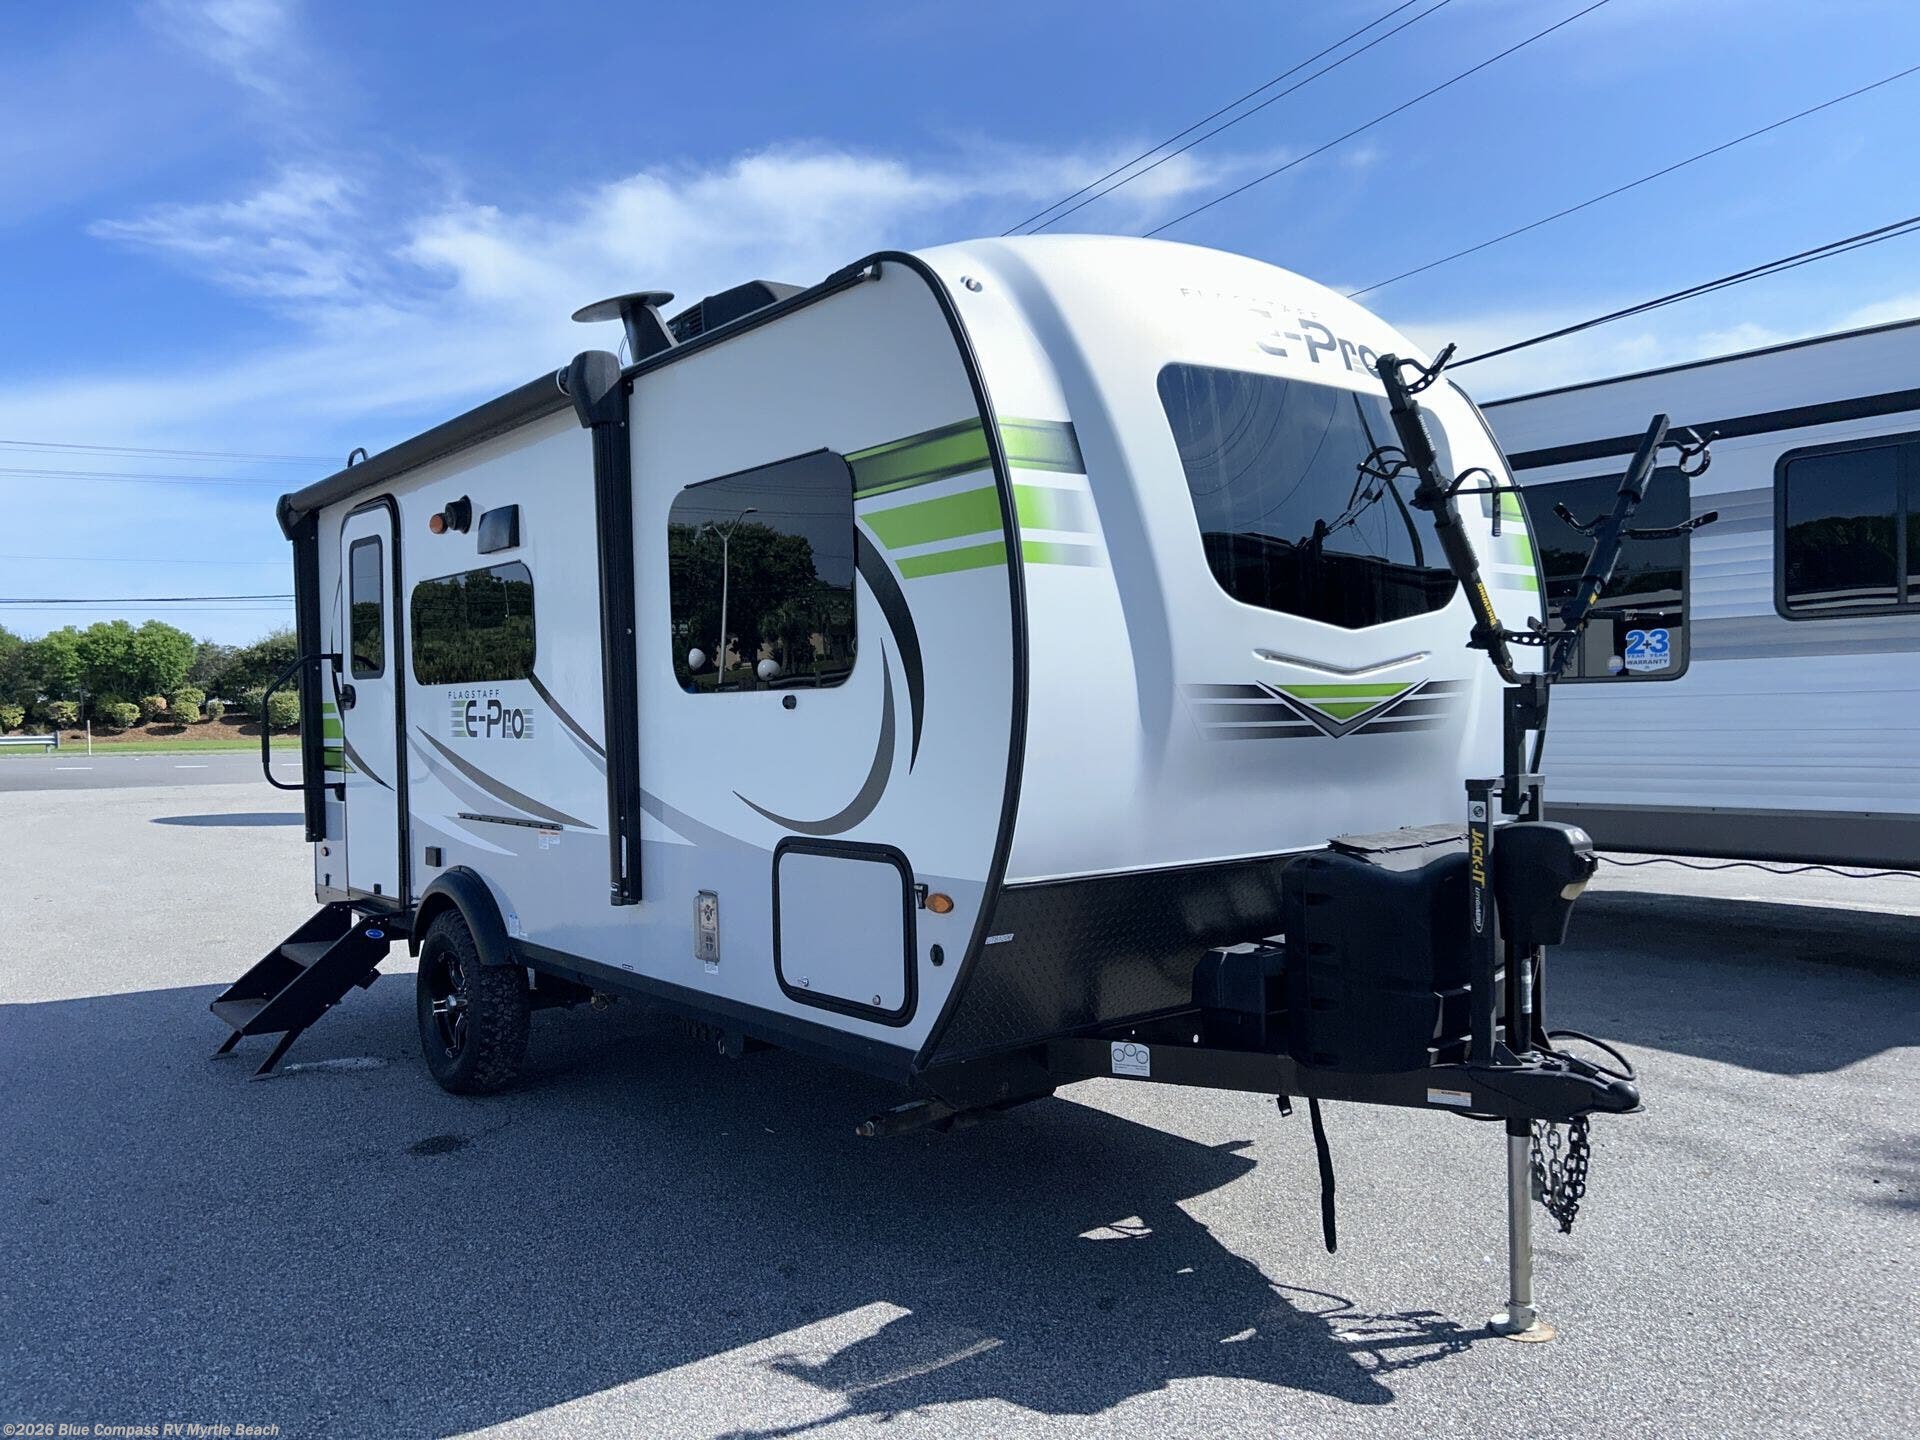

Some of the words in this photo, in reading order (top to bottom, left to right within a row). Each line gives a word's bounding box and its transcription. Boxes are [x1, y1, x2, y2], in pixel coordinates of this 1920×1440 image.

[448, 689, 500, 699] FLAGSTAFF
[464, 699, 525, 740] E-Pro
[1471, 827, 1486, 889] JACK-IT
